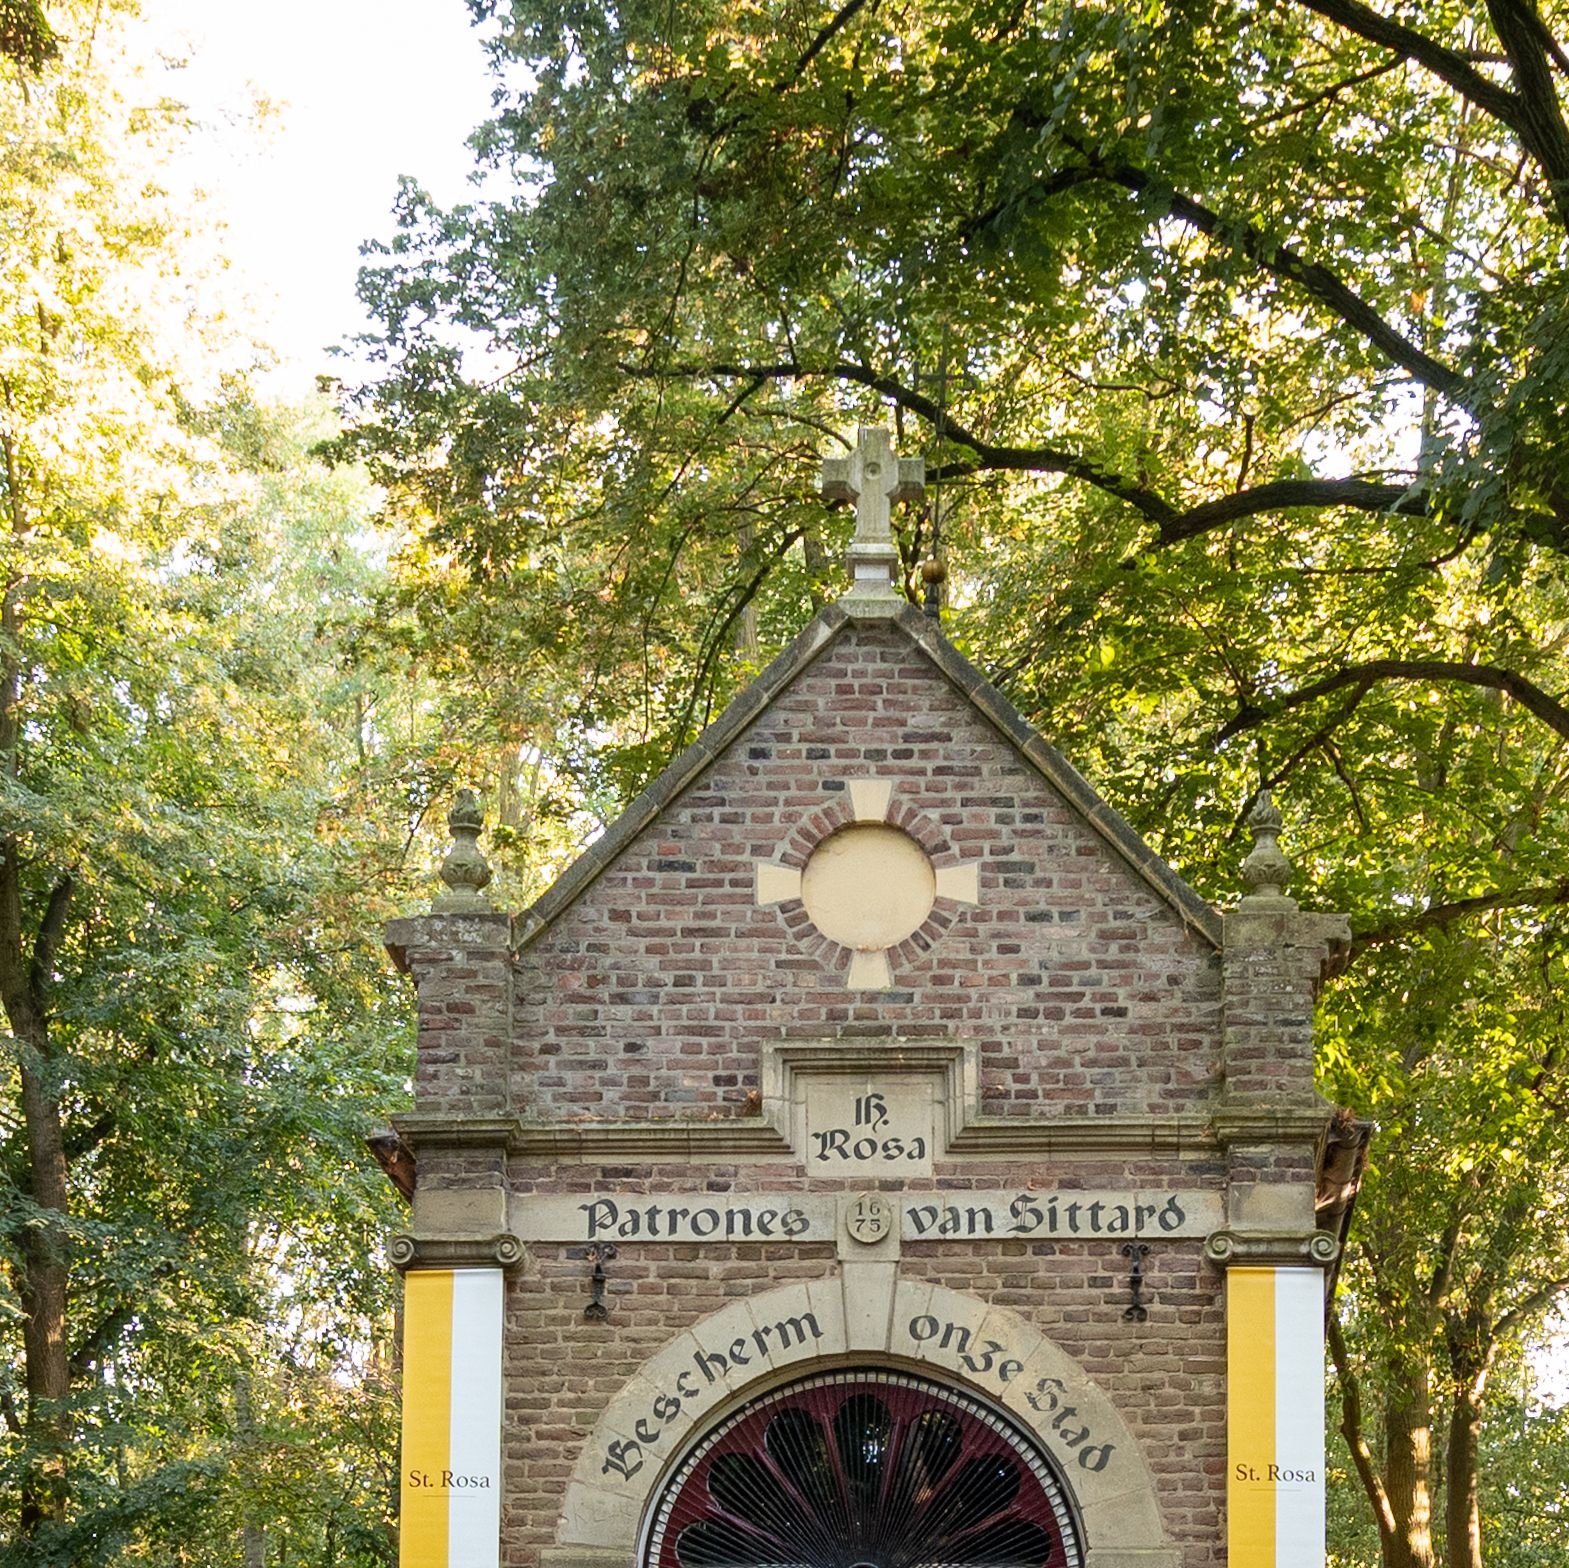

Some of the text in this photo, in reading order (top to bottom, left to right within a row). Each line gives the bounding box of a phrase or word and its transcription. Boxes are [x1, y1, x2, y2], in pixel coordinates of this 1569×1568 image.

[811, 1128, 926, 1161] Rosa
[577, 1193, 1186, 1239] Patrones van Sittard
[855, 1201, 881, 1216] 16
[855, 1218, 881, 1233] 75
[601, 1312, 1117, 1482] Bescherm onze Stad
[408, 1469, 491, 1489] St. Rosa
[1236, 1463, 1316, 1482] St. Rosa
